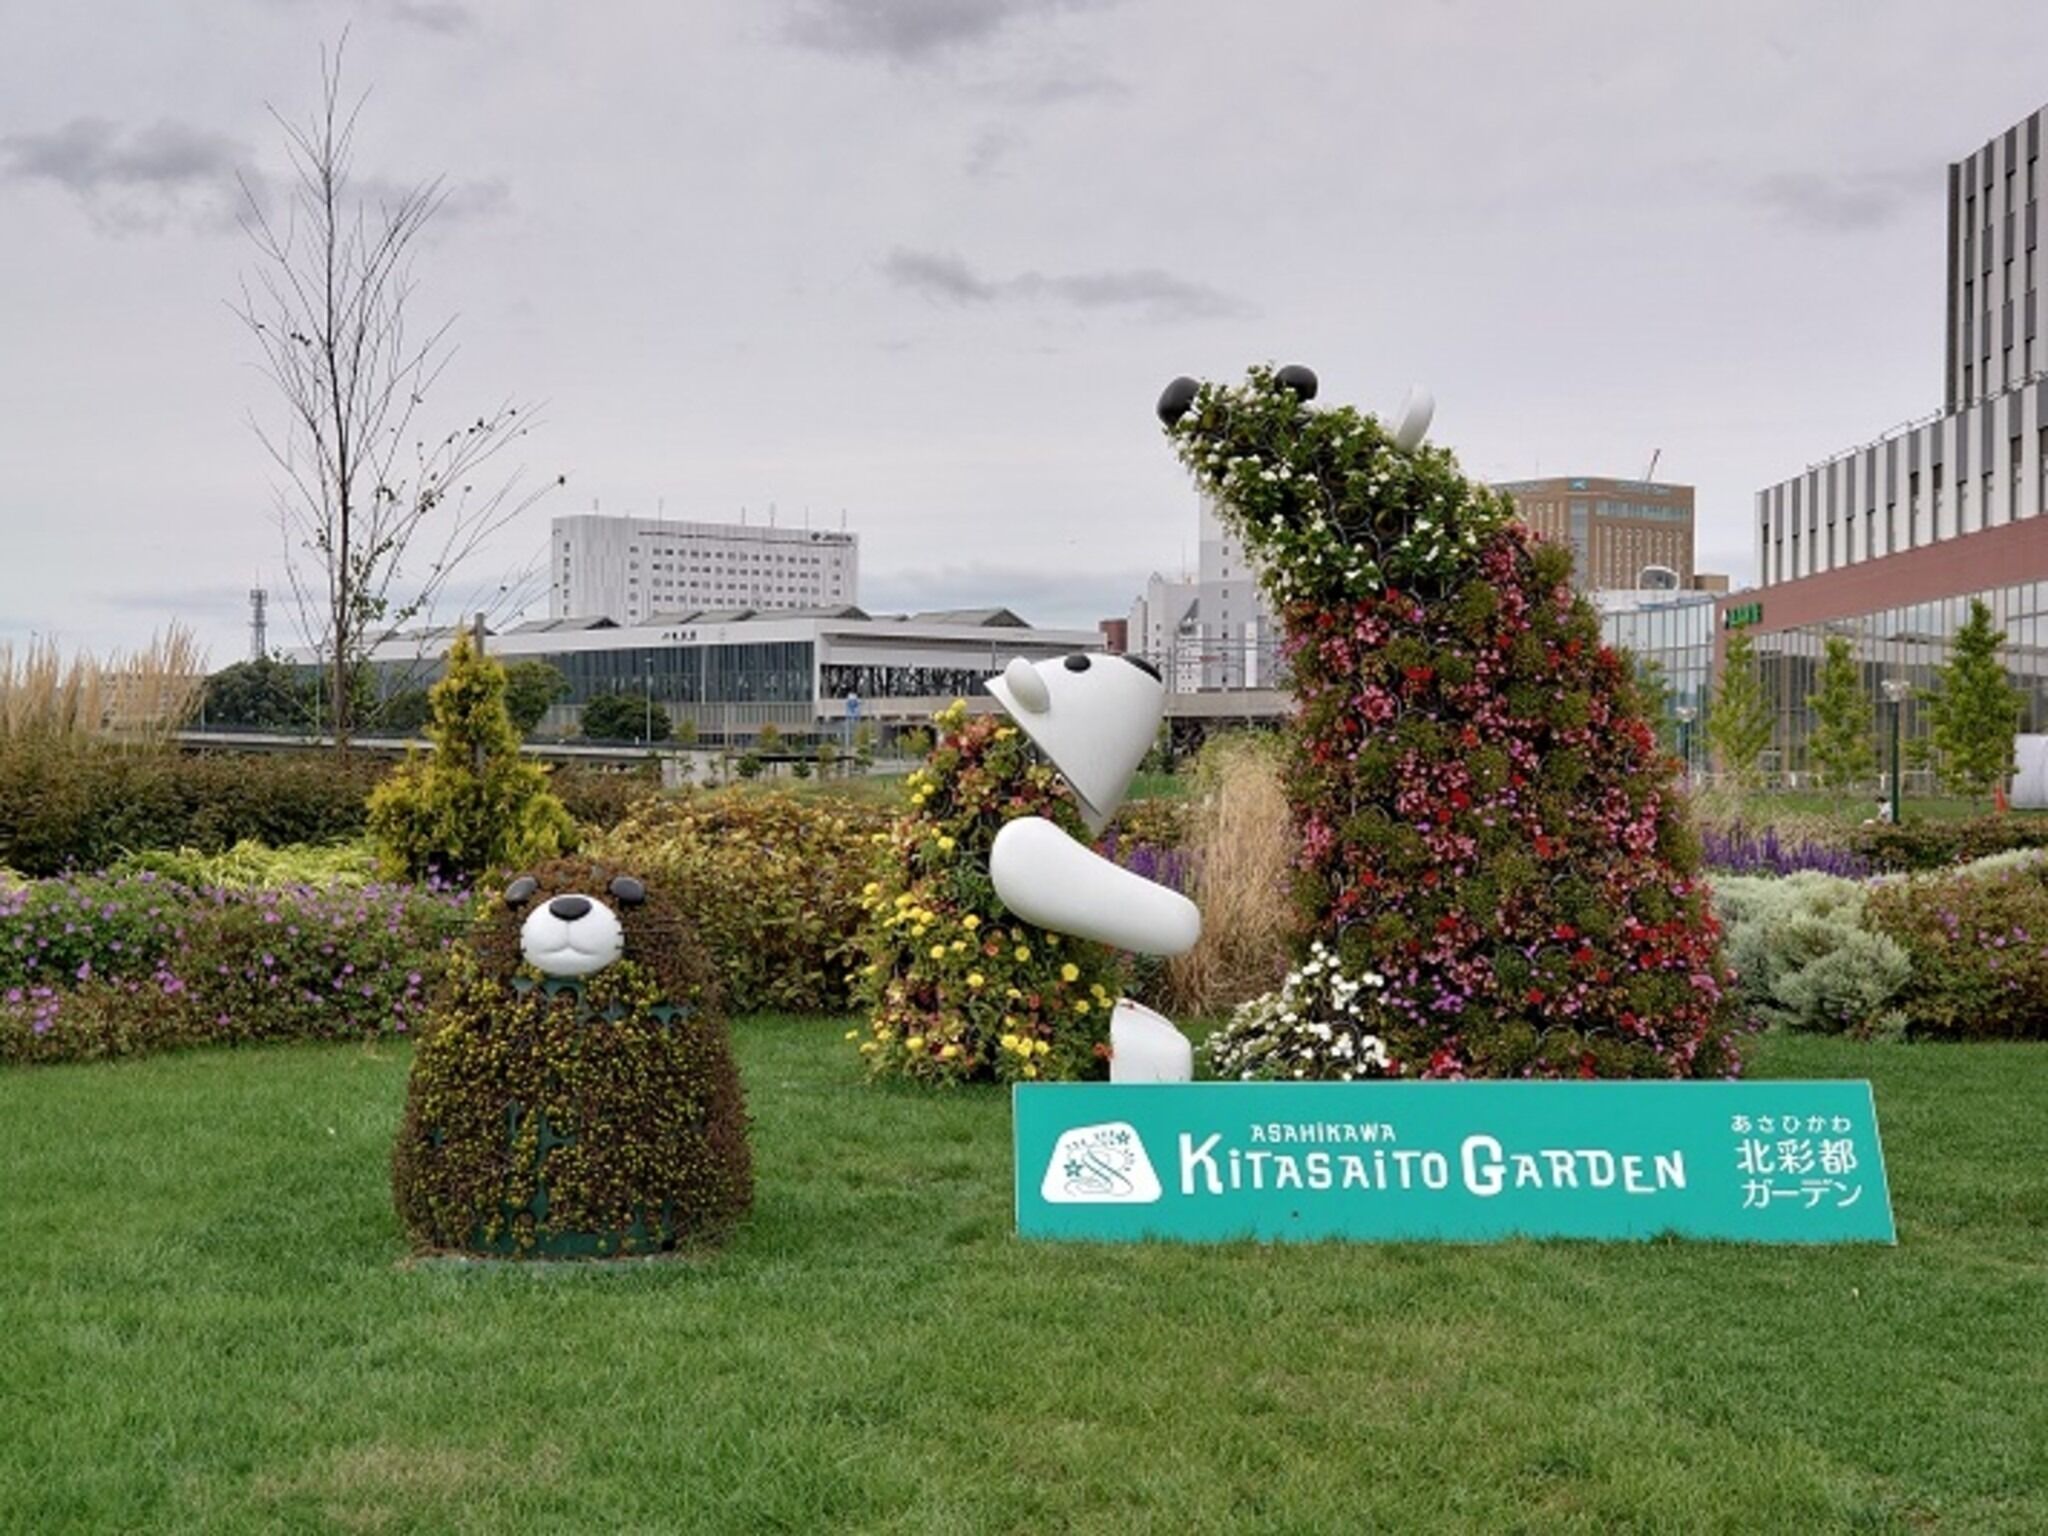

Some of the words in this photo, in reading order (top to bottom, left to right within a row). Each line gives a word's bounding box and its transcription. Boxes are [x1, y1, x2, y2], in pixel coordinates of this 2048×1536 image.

[1732, 1115, 1851, 1133] あさひかわ
[1460, 1134, 1687, 1197] GARDEN
[1736, 1138, 1858, 1175] 北彩都
[1742, 1179, 1862, 1208] ガーデン
